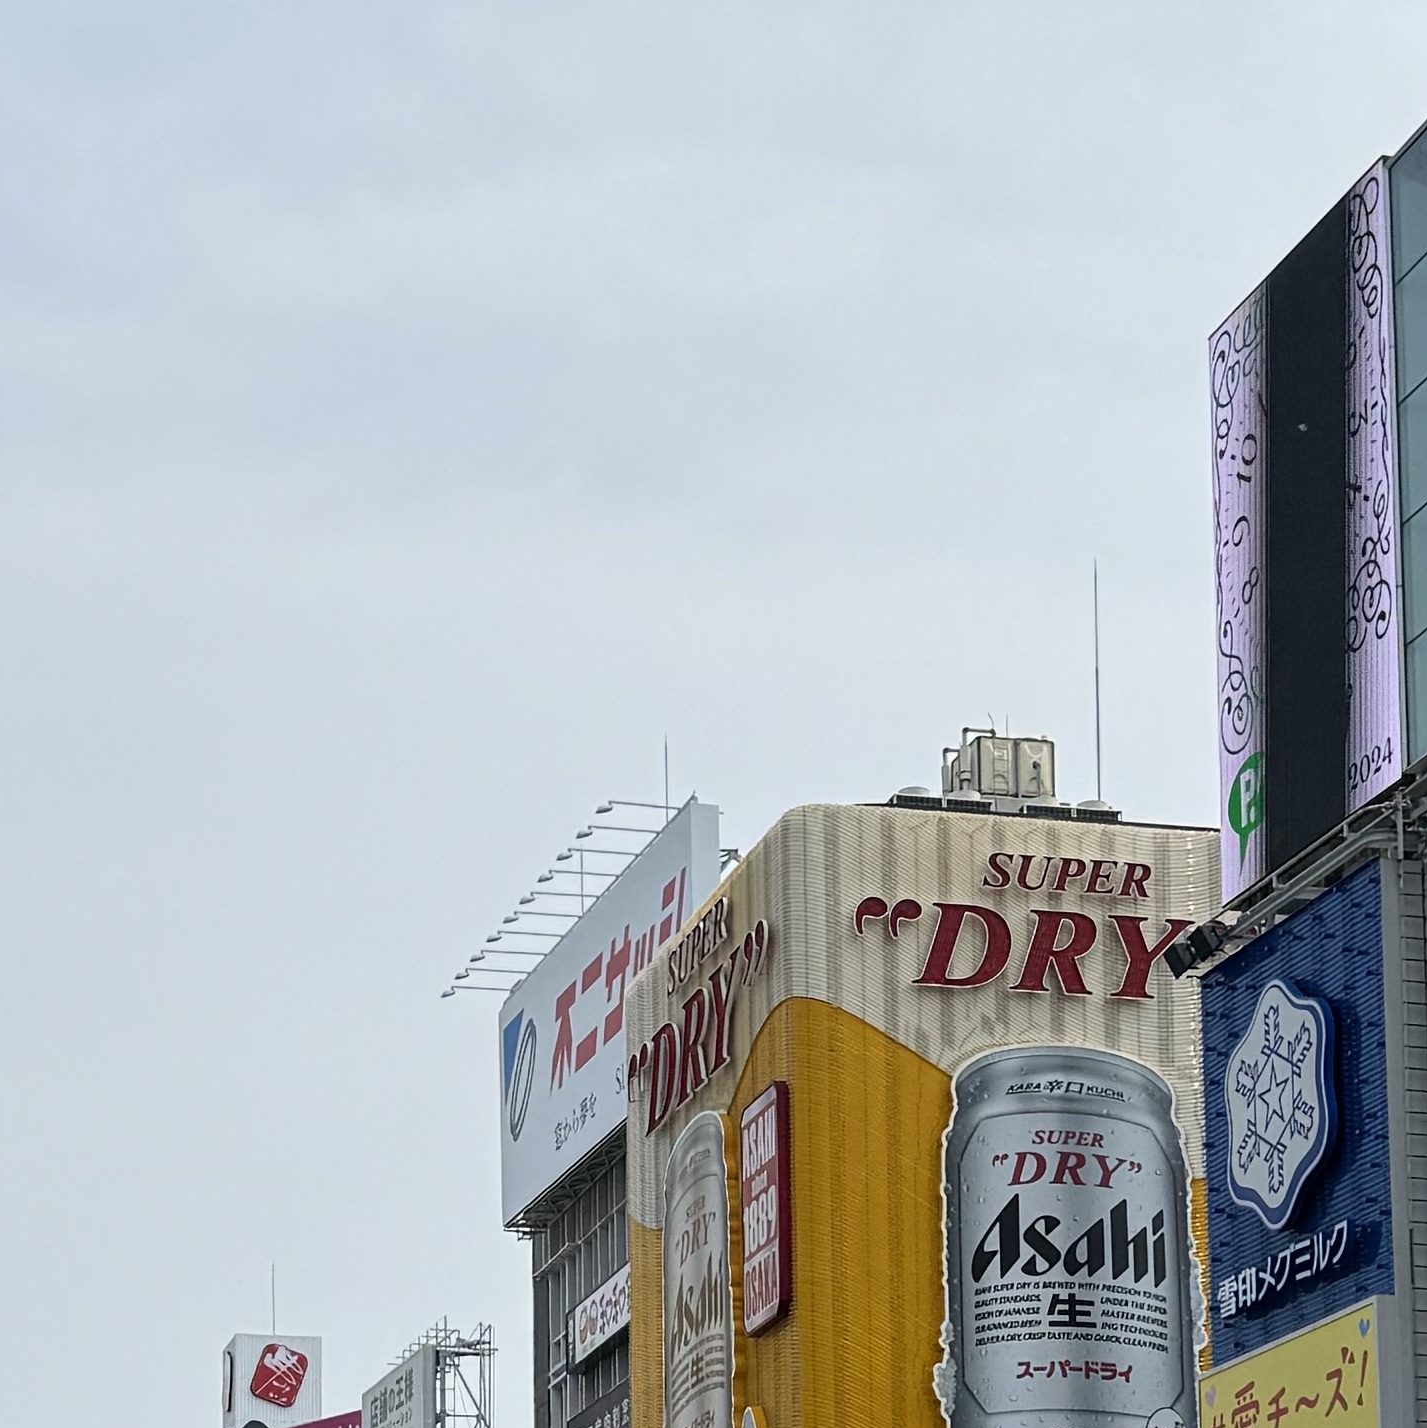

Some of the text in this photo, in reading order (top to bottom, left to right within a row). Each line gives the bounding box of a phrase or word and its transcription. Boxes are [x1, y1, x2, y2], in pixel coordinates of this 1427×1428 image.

[1348, 743, 1395, 793] 2024
[983, 852, 1152, 899] SUPER
[668, 897, 728, 998] SUPER
[742, 1104, 777, 1181] ASAHI
[1032, 1129, 1105, 1149] SUPER
[744, 1184, 777, 1258] 1889
[972, 1193, 1167, 1288] Asahi
[672, 1251, 723, 1354] Asahi
[745, 1250, 778, 1322] OSAKA
[1218, 1220, 1348, 1319] 雪印メグミルク
[1047, 1292, 1098, 1329] 生
[1016, 1360, 1134, 1383] スーパードライ
